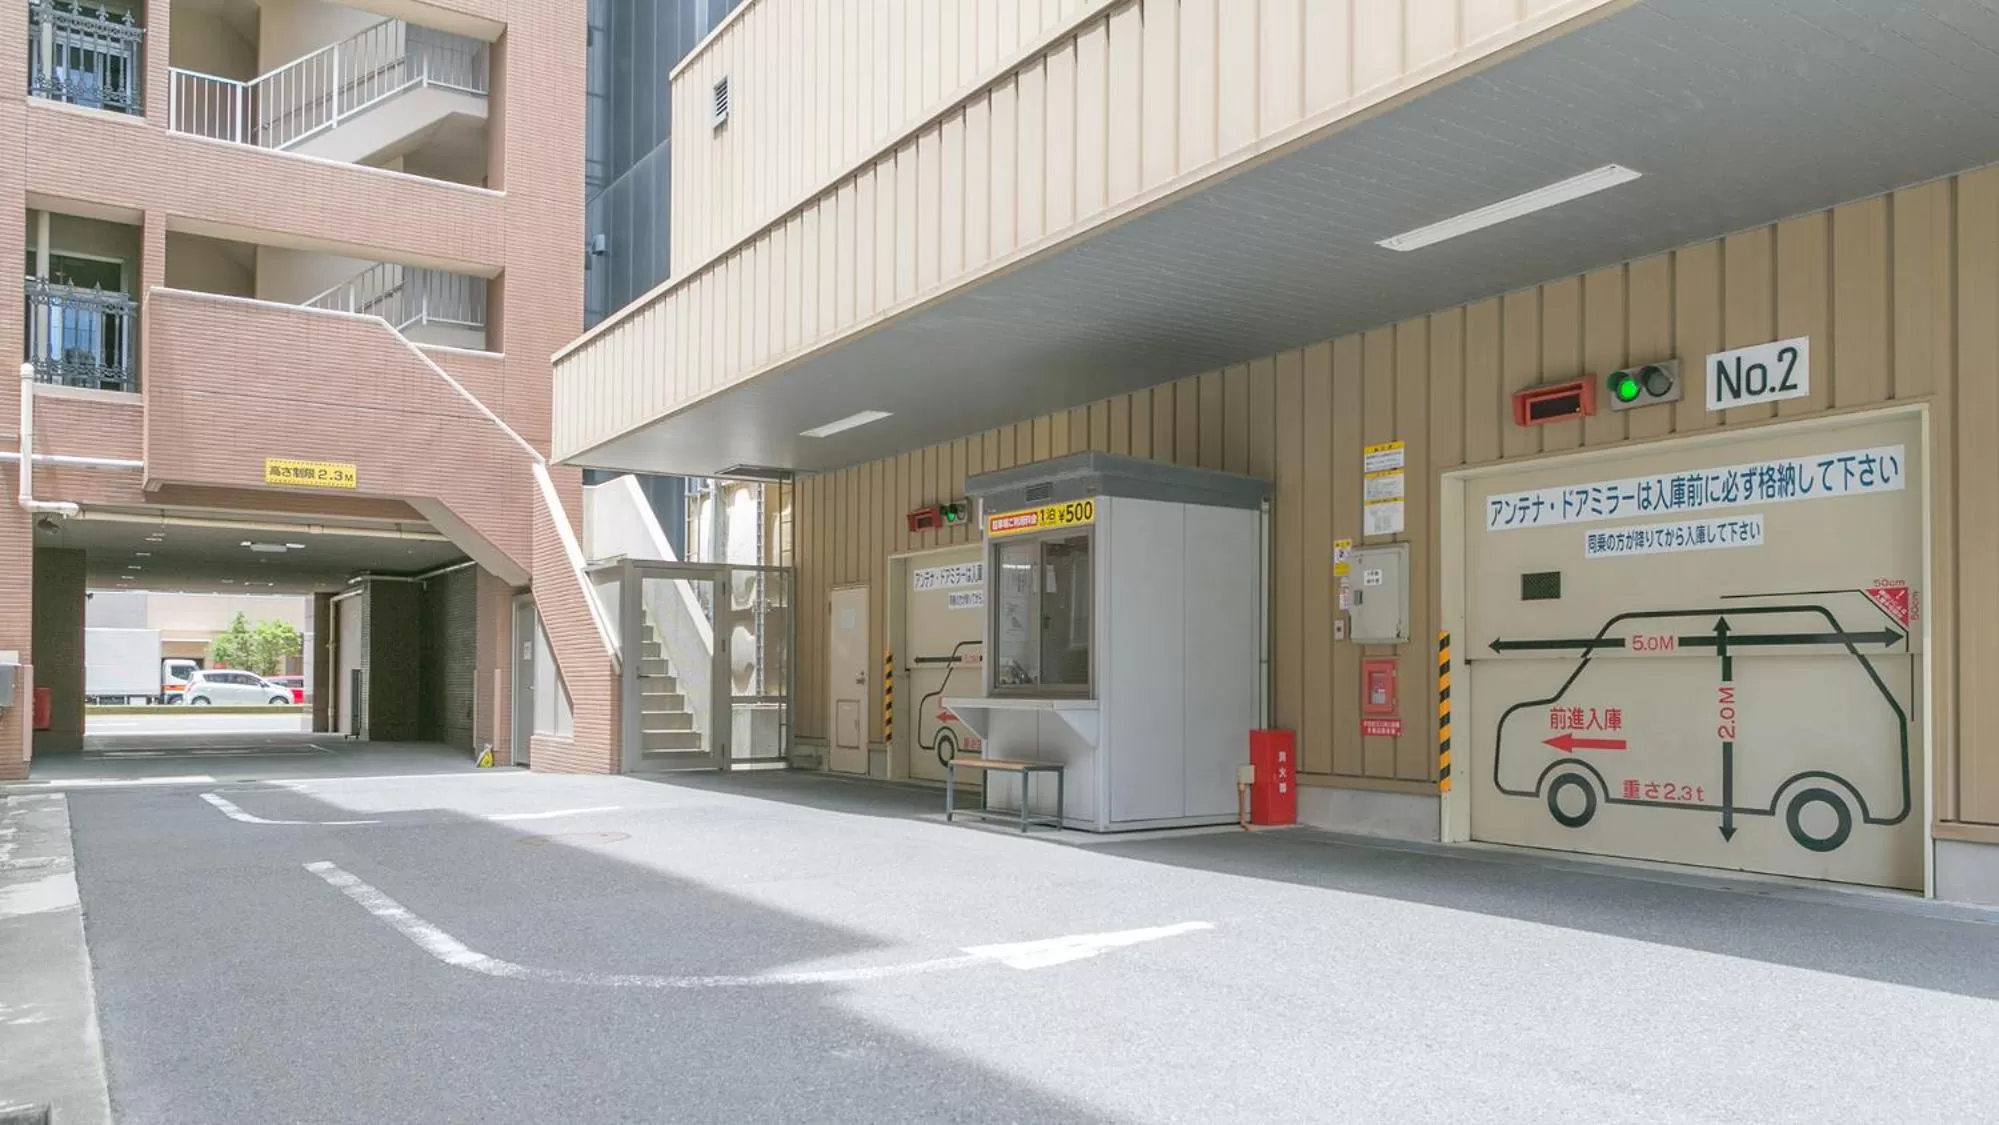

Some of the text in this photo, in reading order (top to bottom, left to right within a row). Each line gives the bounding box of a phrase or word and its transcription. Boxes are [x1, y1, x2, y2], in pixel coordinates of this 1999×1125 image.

[1716, 347, 1798, 402] No.2
[1490, 454, 1899, 526] アンテナ・ドアミラーは入庫前に必ず格納して下さい
[1587, 521, 1761, 553] 同乗の方が降りてから入庫して下さい
[1631, 635, 1675, 651] 5.0M
[1549, 706, 1622, 731] 前進入庫
[1717, 686, 1736, 739] 2.0M
